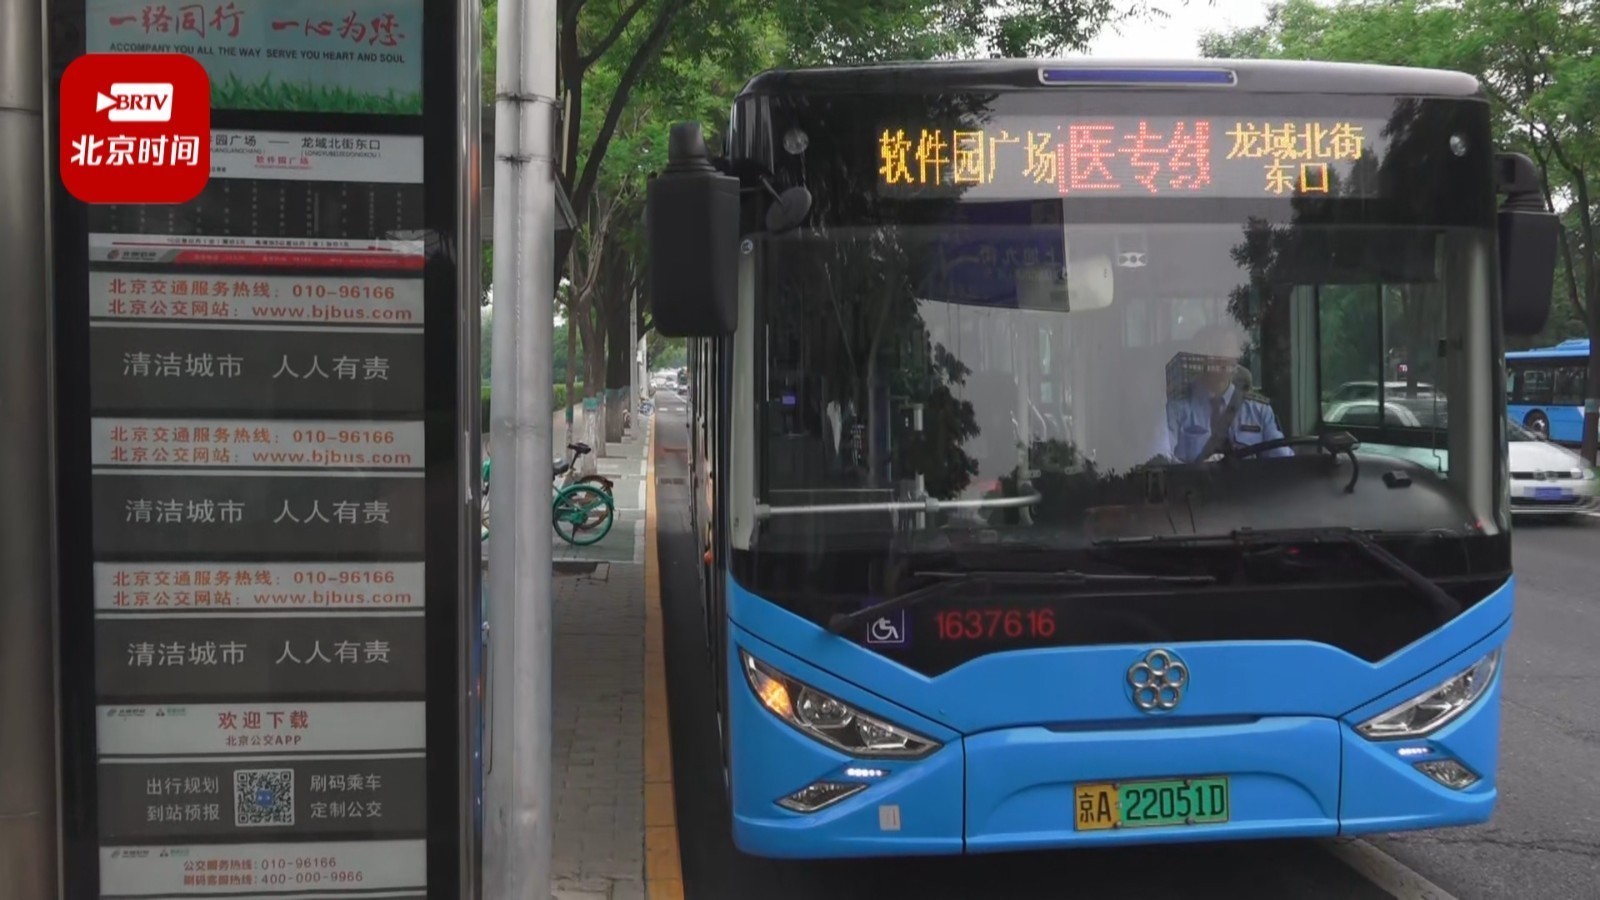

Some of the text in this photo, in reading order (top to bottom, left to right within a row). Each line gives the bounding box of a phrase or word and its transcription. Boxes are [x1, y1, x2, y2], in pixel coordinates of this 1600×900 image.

[109, 2, 405, 46] 一路同行 一心为您
[110, 43, 405, 63] ACCOMPANY YOU ALL THE WAY SERVE YOU HEART AND SOUL
[301, 136, 381, 150] 龙域北街东口
[879, 128, 1057, 187] 软件园广场
[1225, 121, 1365, 160] 龙域北街
[1263, 160, 1330, 193] 东口
[292, 284, 395, 299] 010-96166
[252, 303, 413, 321] www.bjbus.com
[122, 351, 391, 381] 清洁城市 人人有责
[292, 430, 395, 444] 010-96166
[252, 449, 412, 466] www.bjbus.com
[125, 498, 391, 525] 清洁城市 人人有责
[293, 571, 395, 585] 010-96166
[253, 590, 412, 607] www.bjbus.com
[936, 609, 1056, 640] 1637616
[127, 639, 391, 667] 清洁城市 人人有责
[217, 711, 310, 730] 欢迎下载
[225, 734, 302, 747] 北京公交APP
[146, 776, 220, 796] 出行规划
[309, 773, 382, 793] 刷码乘车
[147, 803, 220, 822] 到站预报
[310, 800, 383, 819] 定制公交
[1078, 784, 1226, 823] 京A 22051D
[261, 856, 337, 870] 010-96166
[261, 871, 364, 885] 400-000-9966
